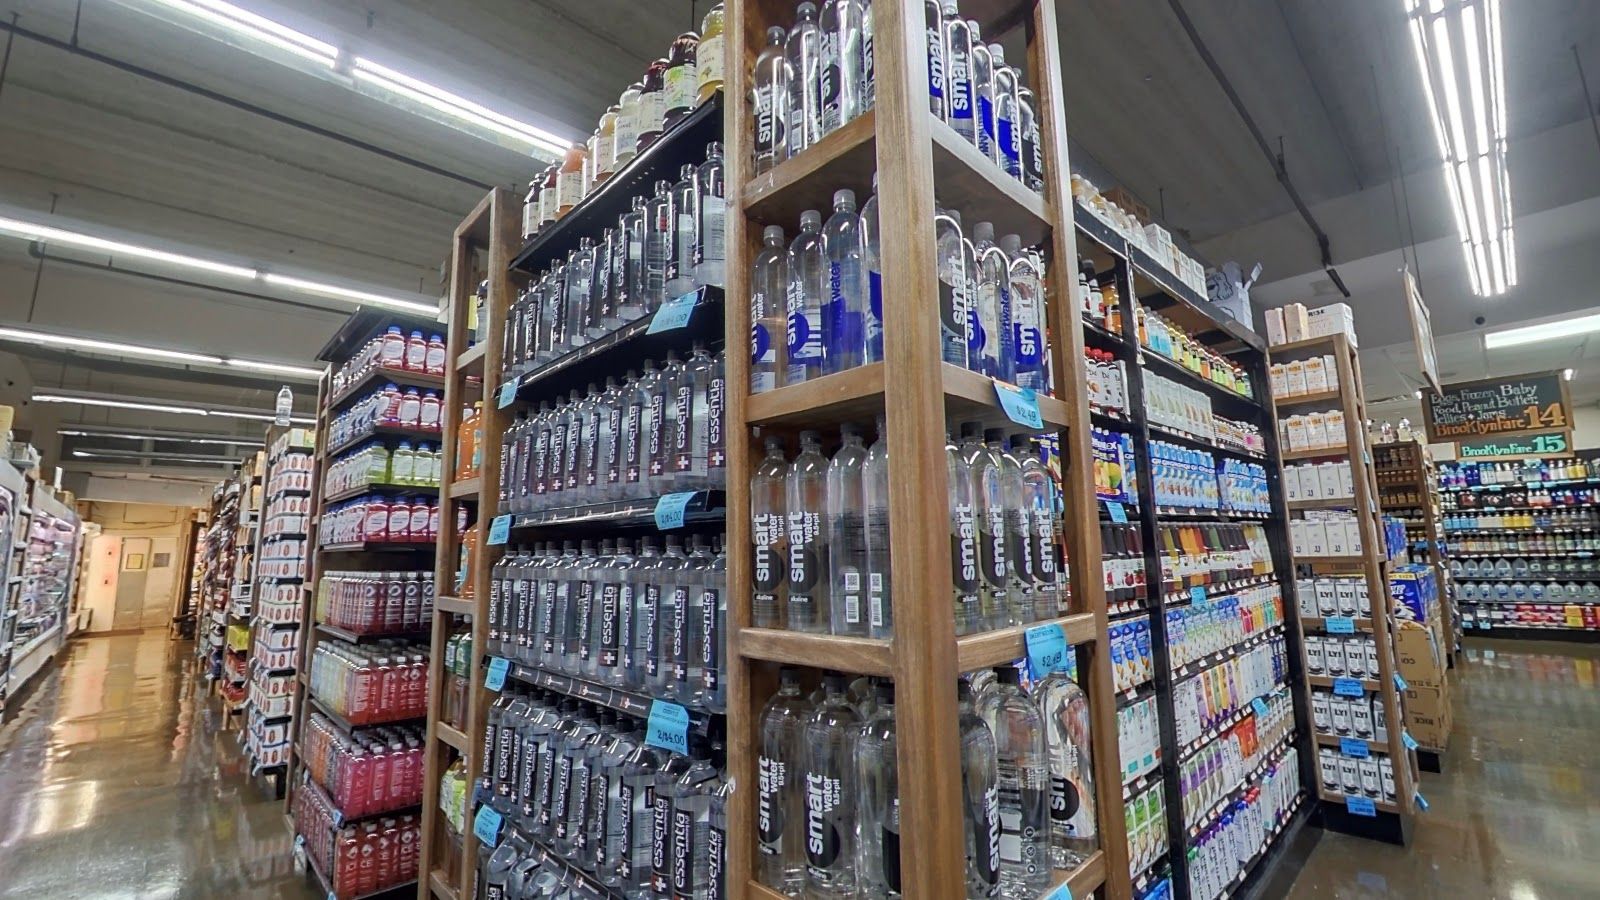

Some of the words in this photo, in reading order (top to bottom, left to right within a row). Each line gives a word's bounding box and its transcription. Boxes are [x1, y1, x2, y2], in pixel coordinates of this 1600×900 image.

[952, 51, 968, 111] smart
[758, 82, 772, 143] smart
[1020, 297, 1035, 356] smart
[677, 387, 688, 449] essentia
[710, 379, 720, 444] essentia
[1500, 383, 1537, 397] Baby
[1523, 403, 1567, 429] 14
[650, 395, 661, 454] essentia
[1531, 435, 1567, 454] 15
[754, 513, 768, 582] smart
[769, 513, 778, 544] water
[788, 511, 803, 582] smart
[803, 511, 813, 543] water
[956, 504, 975, 581] smart
[990, 504, 1006, 577] smart
[1035, 508, 1053, 573] smart
[602, 586, 614, 646] essentia
[673, 589, 682, 656] essentia
[702, 592, 711, 663] essentia
[500, 729, 510, 779] essentia
[524, 742, 536, 797] essentia
[769, 759, 778, 792] water
[759, 755, 770, 832] smart
[806, 771, 823, 855] smart
[822, 775, 833, 812] water
[653, 797, 664, 868] essentia
[674, 812, 685, 888] essentia
[985, 784, 999, 872] smart
